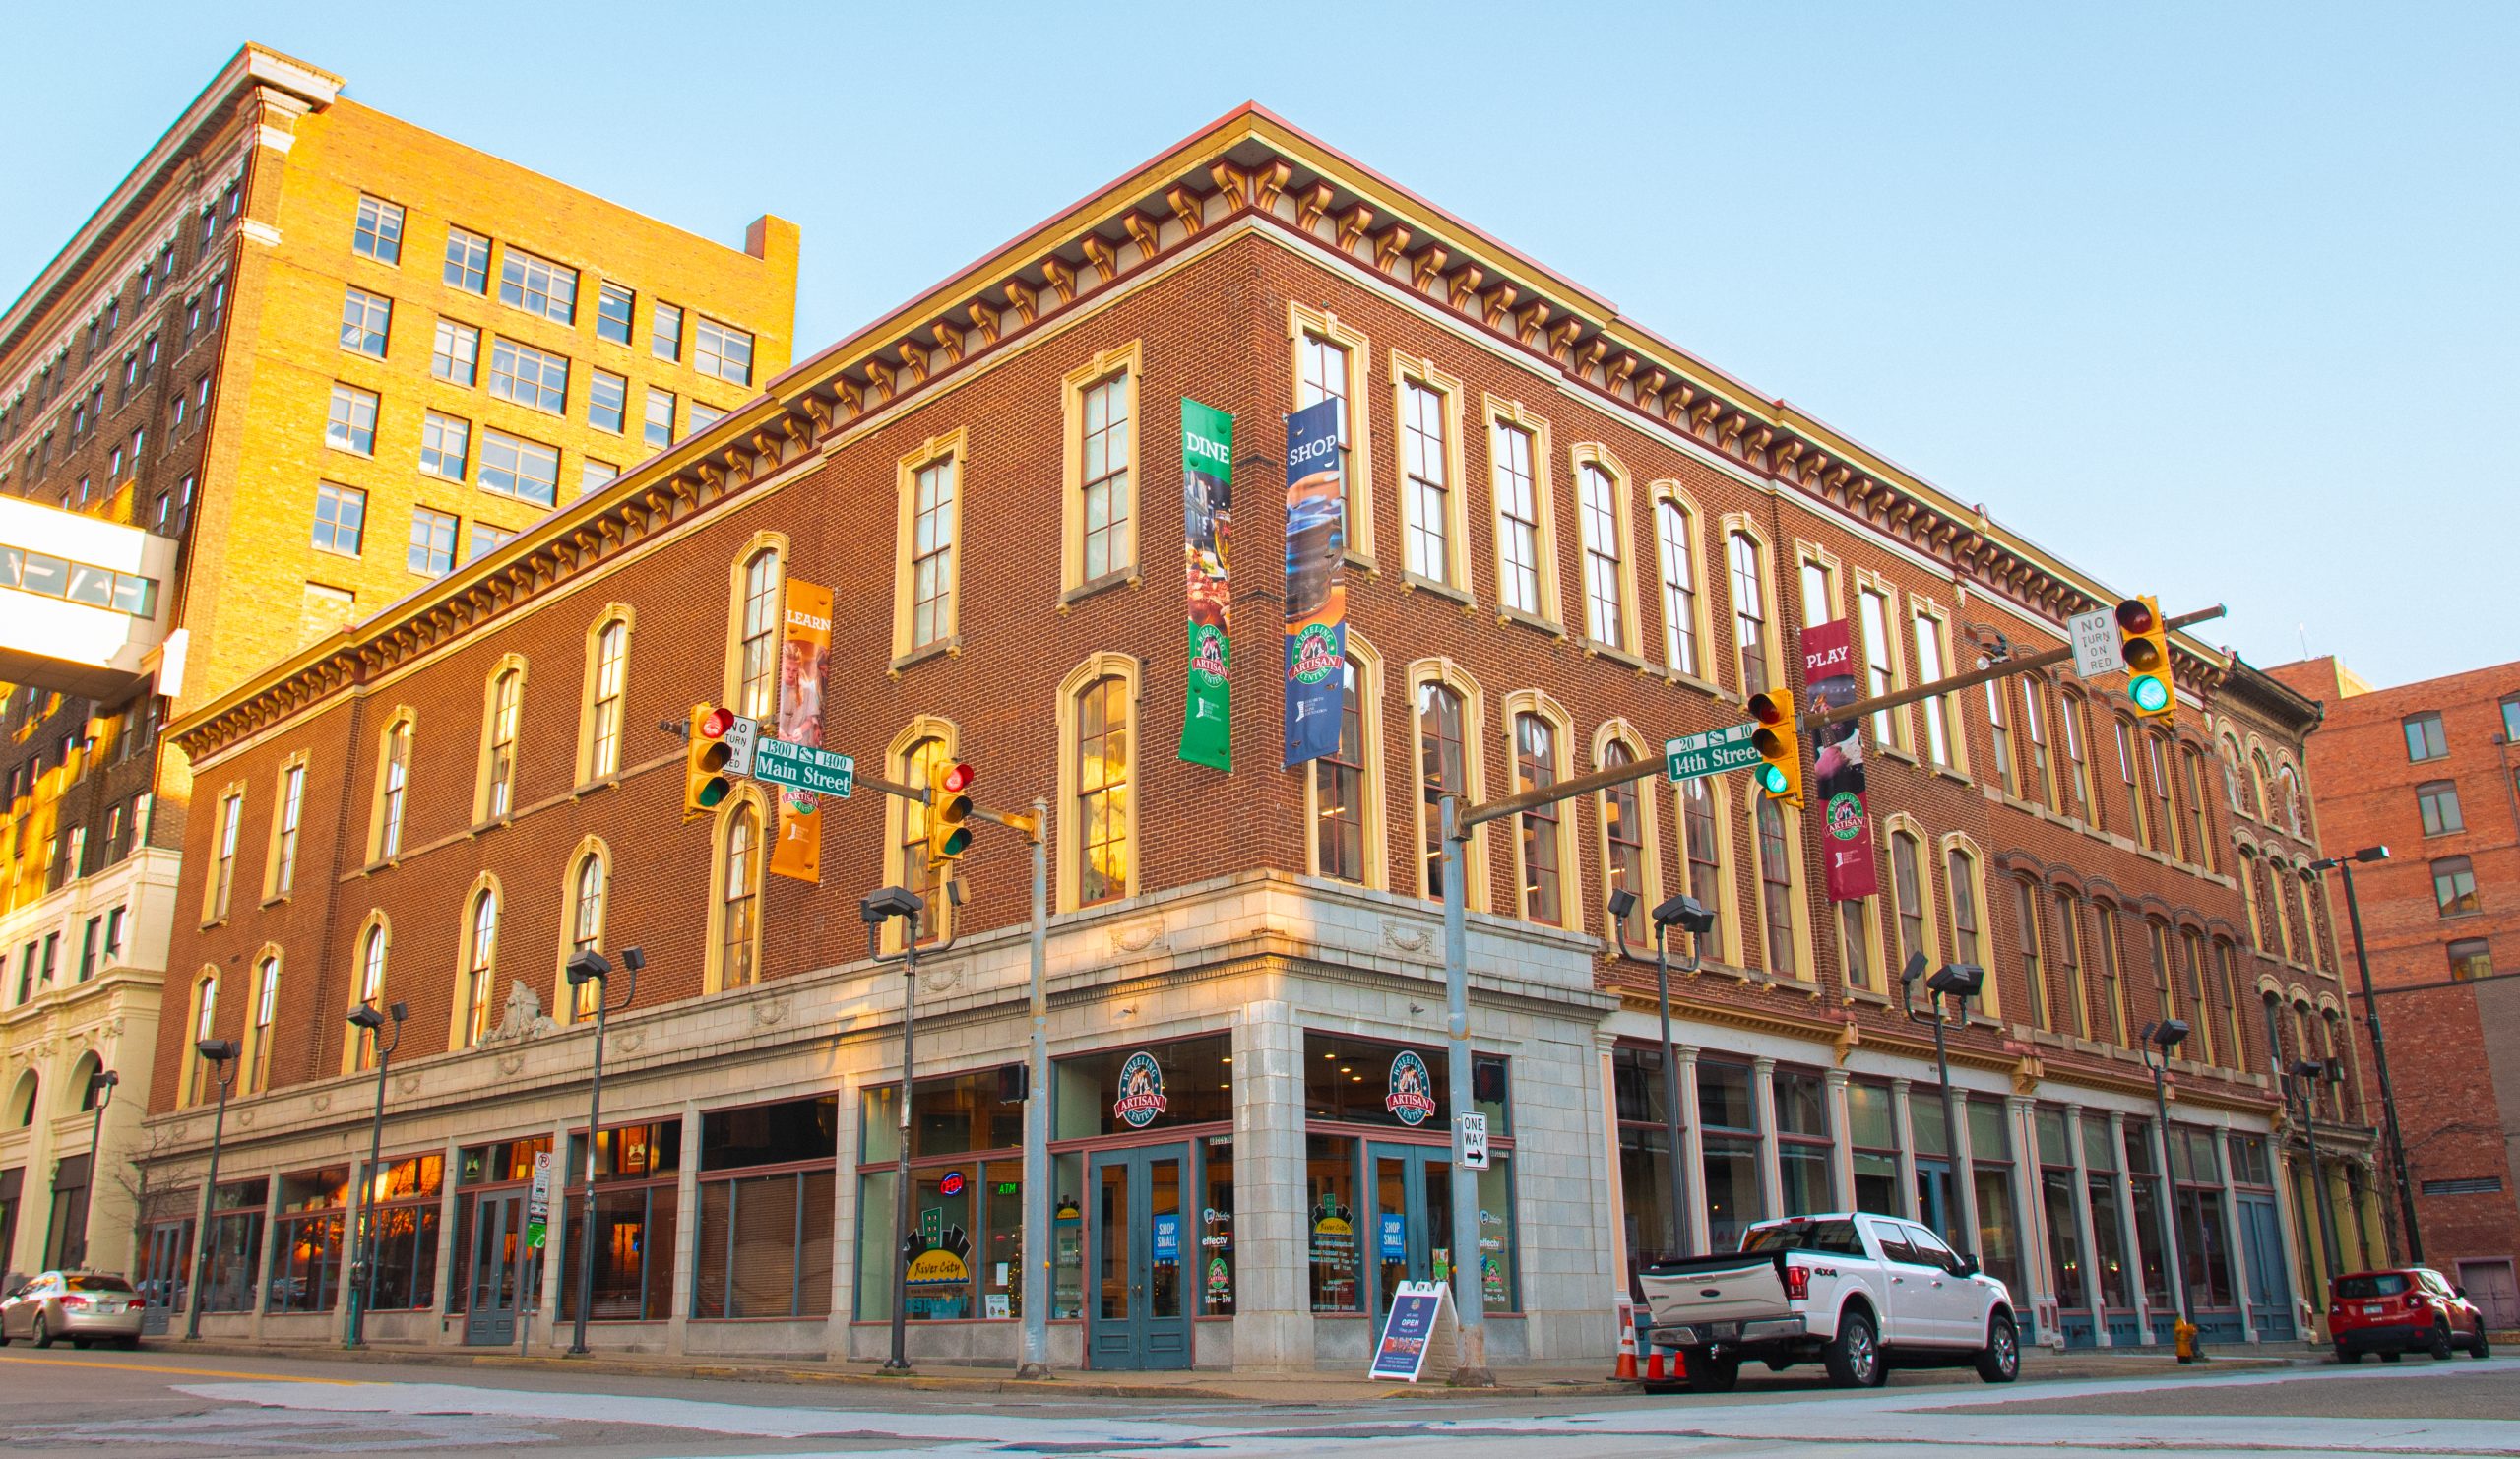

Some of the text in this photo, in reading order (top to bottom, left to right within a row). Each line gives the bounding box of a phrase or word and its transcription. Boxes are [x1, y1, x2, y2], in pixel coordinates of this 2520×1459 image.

[1186, 431, 1229, 465] DINE
[1290, 434, 1337, 466] SHOP
[787, 609, 832, 632] LEARN
[2081, 617, 2105, 632] NO
[1197, 626, 1226, 651] WHEELING
[1295, 624, 1334, 649] WHEELING
[2081, 631, 2110, 648] TURN
[1806, 645, 1849, 669] PLAY
[2090, 646, 2107, 657] ON
[1196, 659, 1228, 678] ARTISAN
[1293, 657, 1337, 676] ARTISAN
[2090, 658, 2111, 669] RED
[1201, 669, 1223, 684] CENTER
[1299, 667, 1329, 682] CENTER
[732, 721, 747, 733] NO
[725, 733, 747, 747] TURN
[1679, 724, 1752, 751] 20 10
[767, 739, 847, 769] 1300 1400
[725, 758, 740, 768] ED
[1674, 753, 1708, 775] 14th
[757, 755, 850, 792] Main Street
[788, 792, 819, 808] ARTISAN
[1828, 794, 1859, 811] WHEELING
[1829, 818, 1863, 833] ARTISAN
[1123, 1056, 1158, 1081] WHEELING
[1394, 1055, 1426, 1080] WHEELING
[1121, 1095, 1161, 1111] ARTISAN
[1392, 1094, 1429, 1109] ARTISAN
[1127, 1108, 1154, 1121] CENTER
[1399, 1107, 1424, 1120] CENTER
[1464, 1117, 1483, 1131] ONE
[1464, 1132, 1484, 1147] WAY
[940, 1174, 963, 1194] OPEN
[998, 1182, 1017, 1194] ATM
[1158, 1222, 1175, 1235] SHOP
[1384, 1221, 1401, 1234] SHOP
[1157, 1235, 1176, 1247] SMALL
[1383, 1234, 1402, 1246] SMALL
[914, 1260, 961, 1278] River City
[1401, 1318, 1419, 1327] OPEN
